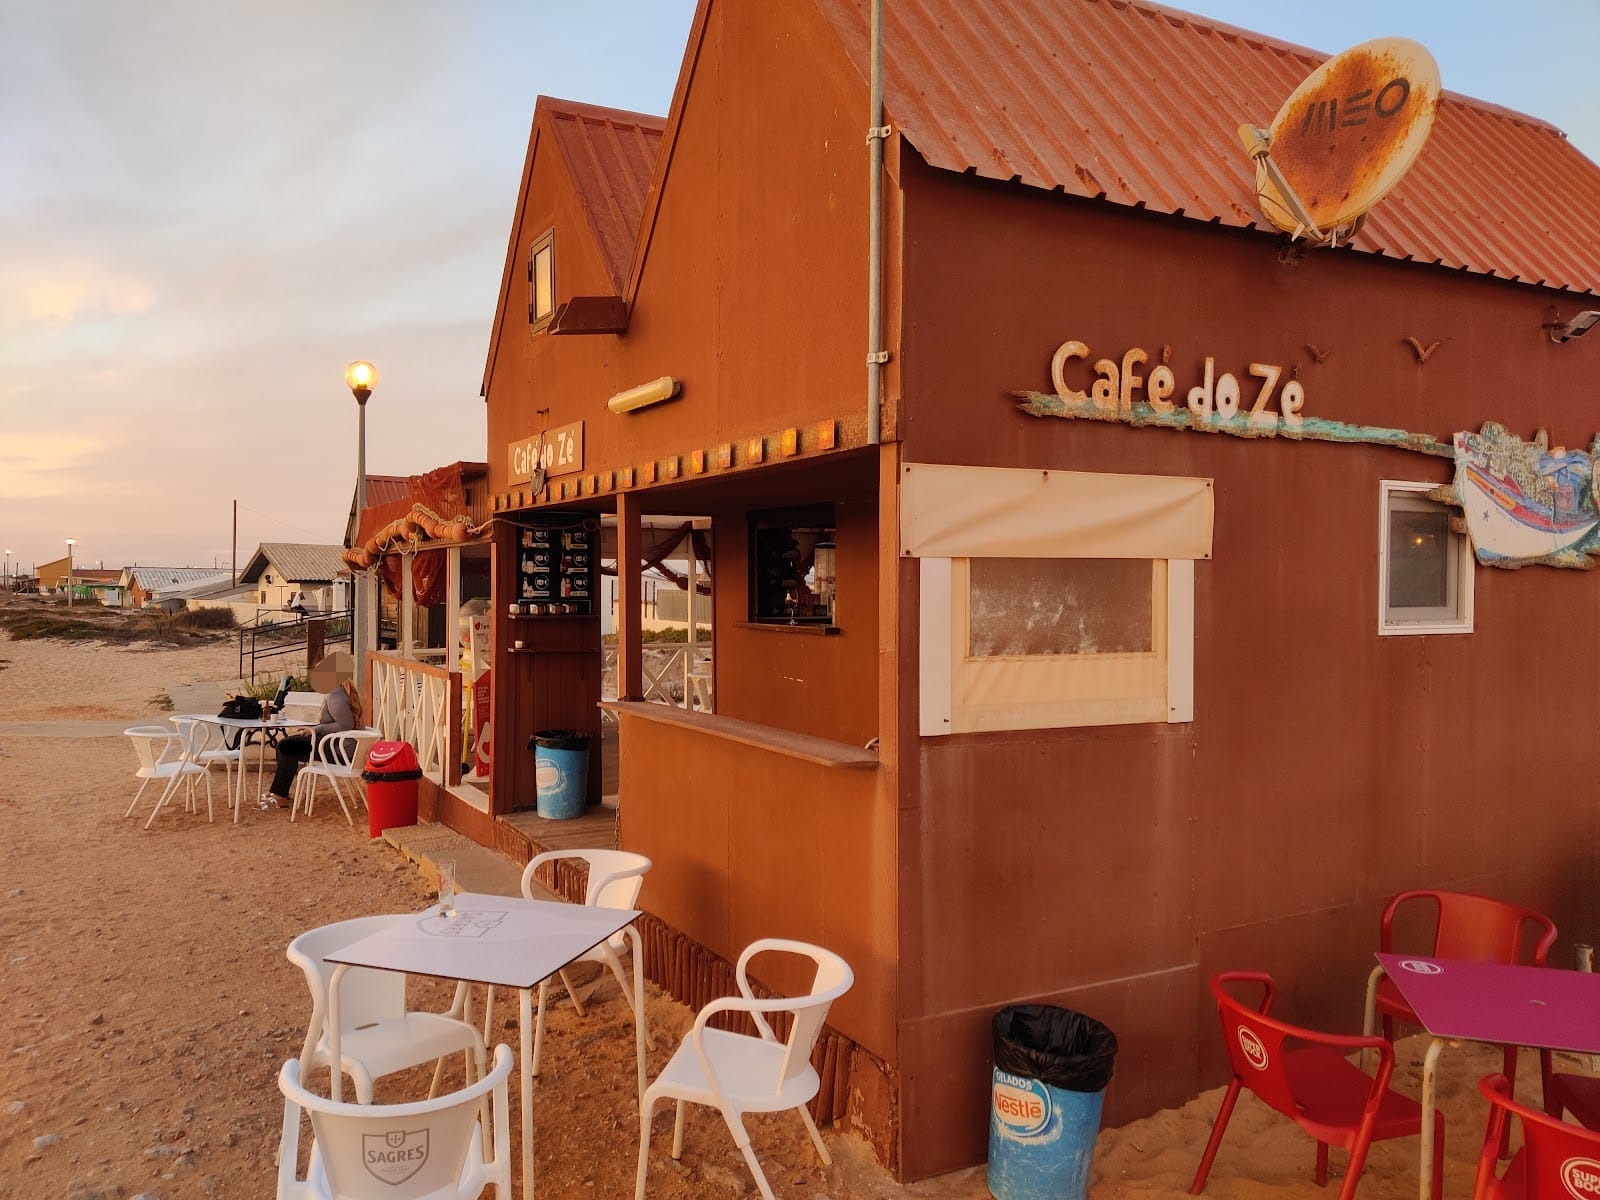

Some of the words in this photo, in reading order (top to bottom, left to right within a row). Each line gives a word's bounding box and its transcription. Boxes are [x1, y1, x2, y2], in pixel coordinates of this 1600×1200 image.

[1301, 77, 1411, 138] MEO
[1051, 340, 1175, 414] Café
[1187, 356, 1241, 422] do
[1248, 363, 1305, 425] Zé
[514, 440, 538, 476] Café
[557, 430, 574, 466] Zé
[367, 1144, 425, 1164] SAGRES
[1572, 1168, 1600, 1187] SUP
